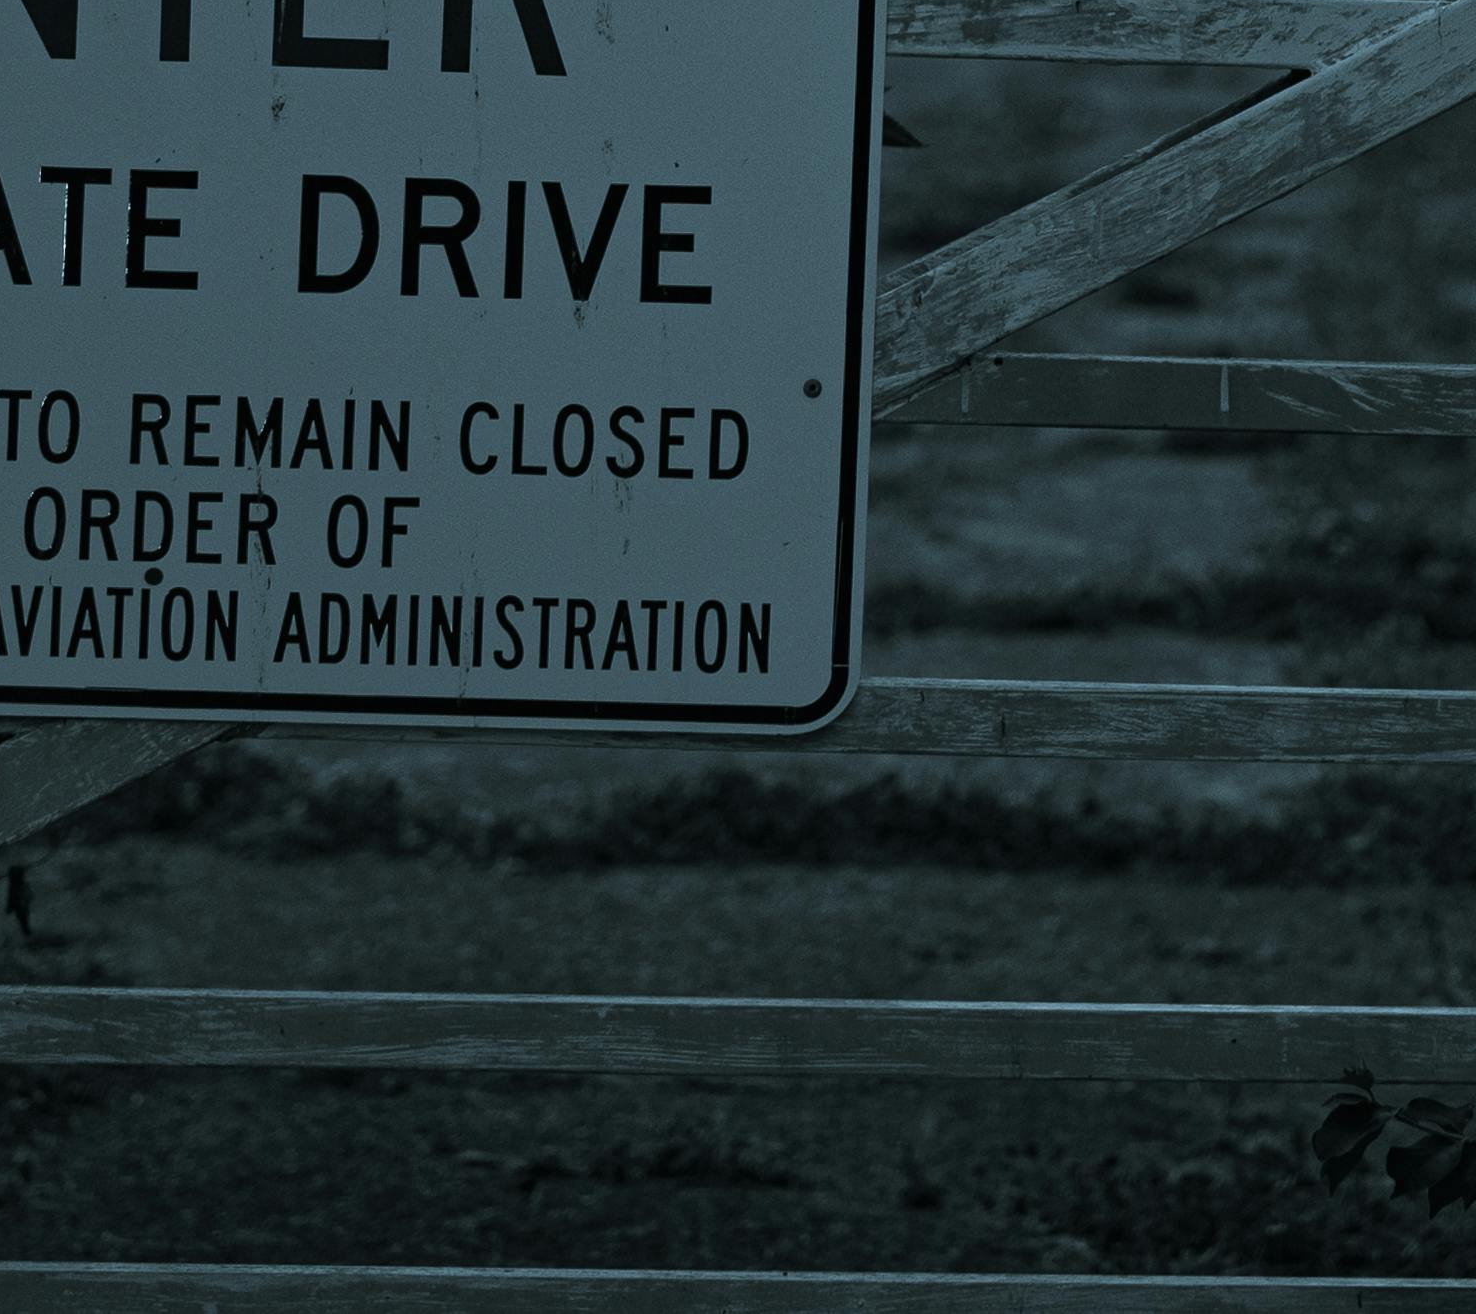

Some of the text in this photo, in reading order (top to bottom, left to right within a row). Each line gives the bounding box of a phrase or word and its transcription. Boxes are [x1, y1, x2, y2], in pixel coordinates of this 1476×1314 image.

[297, 175, 713, 305] DRIVE
[127, 394, 412, 472] REMAIN
[458, 400, 750, 482] CLOSED
[22, 487, 279, 565] ORDER
[326, 495, 422, 569] OF
[273, 593, 773, 673] ADMINISTRATION
